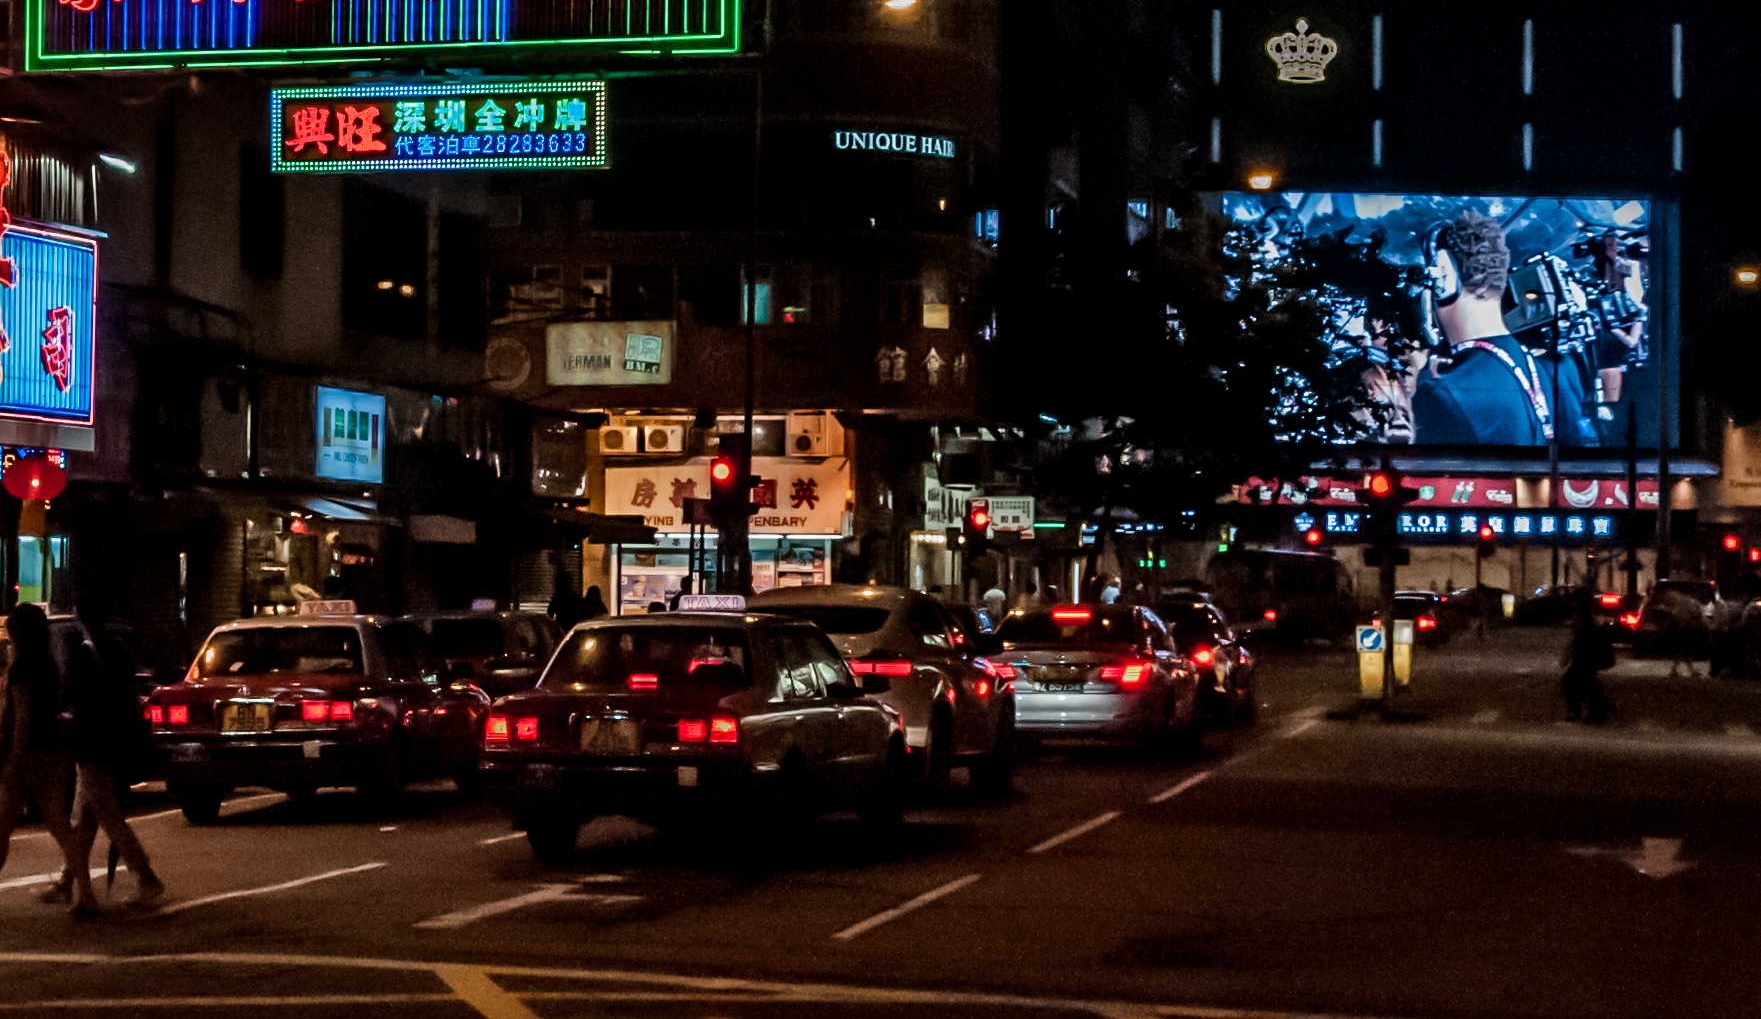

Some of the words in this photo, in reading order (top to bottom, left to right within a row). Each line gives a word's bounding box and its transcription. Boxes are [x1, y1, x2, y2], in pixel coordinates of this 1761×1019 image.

[285, 106, 387, 155] 興旺
[835, 131, 918, 152] UNIQUE
[920, 135, 955, 158] HAIR
[684, 596, 740, 610] TAXI
